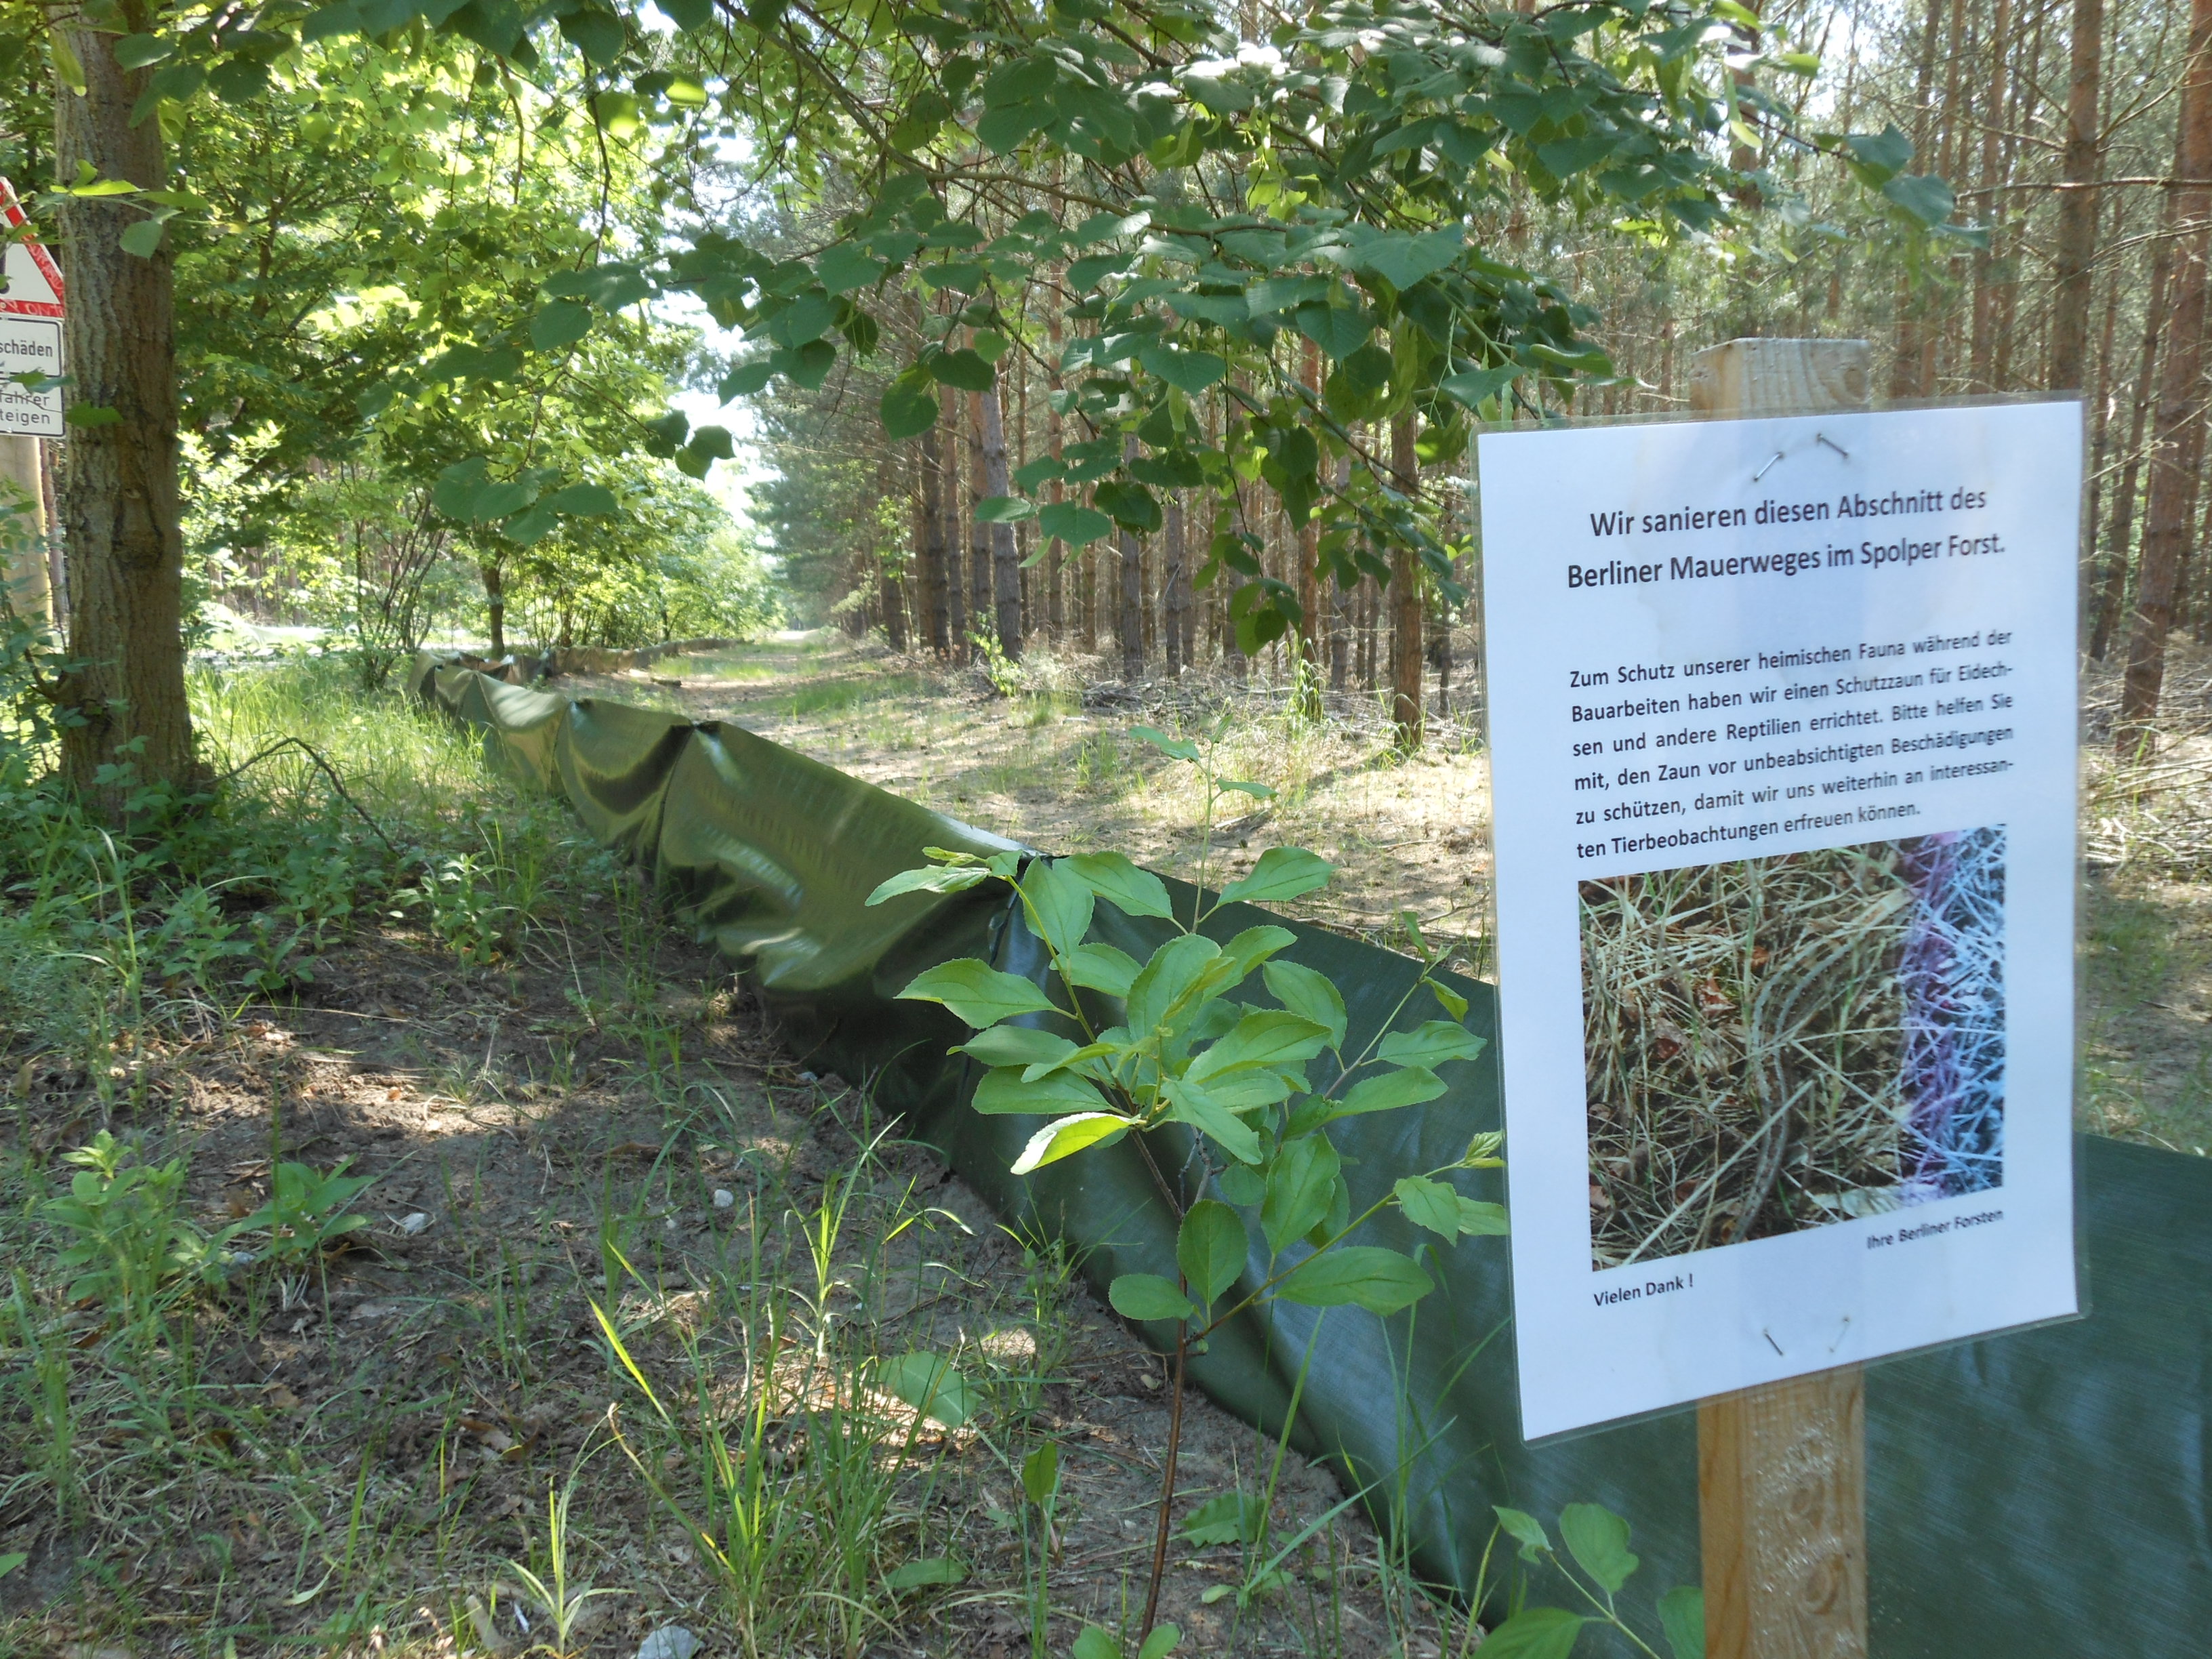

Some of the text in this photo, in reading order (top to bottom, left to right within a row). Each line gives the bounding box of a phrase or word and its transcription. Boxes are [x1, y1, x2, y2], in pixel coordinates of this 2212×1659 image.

[1589, 486, 1986, 537] Wir sanieren diesen Abschnitt des
[1568, 533, 2005, 588] Berliner Mauerweges im Spolper Forst.
[1570, 629, 2013, 688] Zum Schutz unserer heimischen Fauna während der
[1572, 661, 2013, 722] Bauarbeiten haben wir einen Schutzzaun für Eidech-
[1572, 693, 2013, 757] sen und andere Reptilien errichtet. Bitte helfen Sie
[1574, 728, 2013, 791] mit, den Zaun vor unbeabsichtigten Beschädigungen
[1576, 760, 2014, 825] zu schützen, damit wir uns weiterhin an interessan-
[1576, 804, 1921, 859] ten Tierbeobachtungen erfreuen können.
[1866, 1210, 2003, 1250] Ihre Berliner Forsten
[1593, 1287, 1641, 1307] Vielen
[1645, 1275, 1684, 1296] Dank
